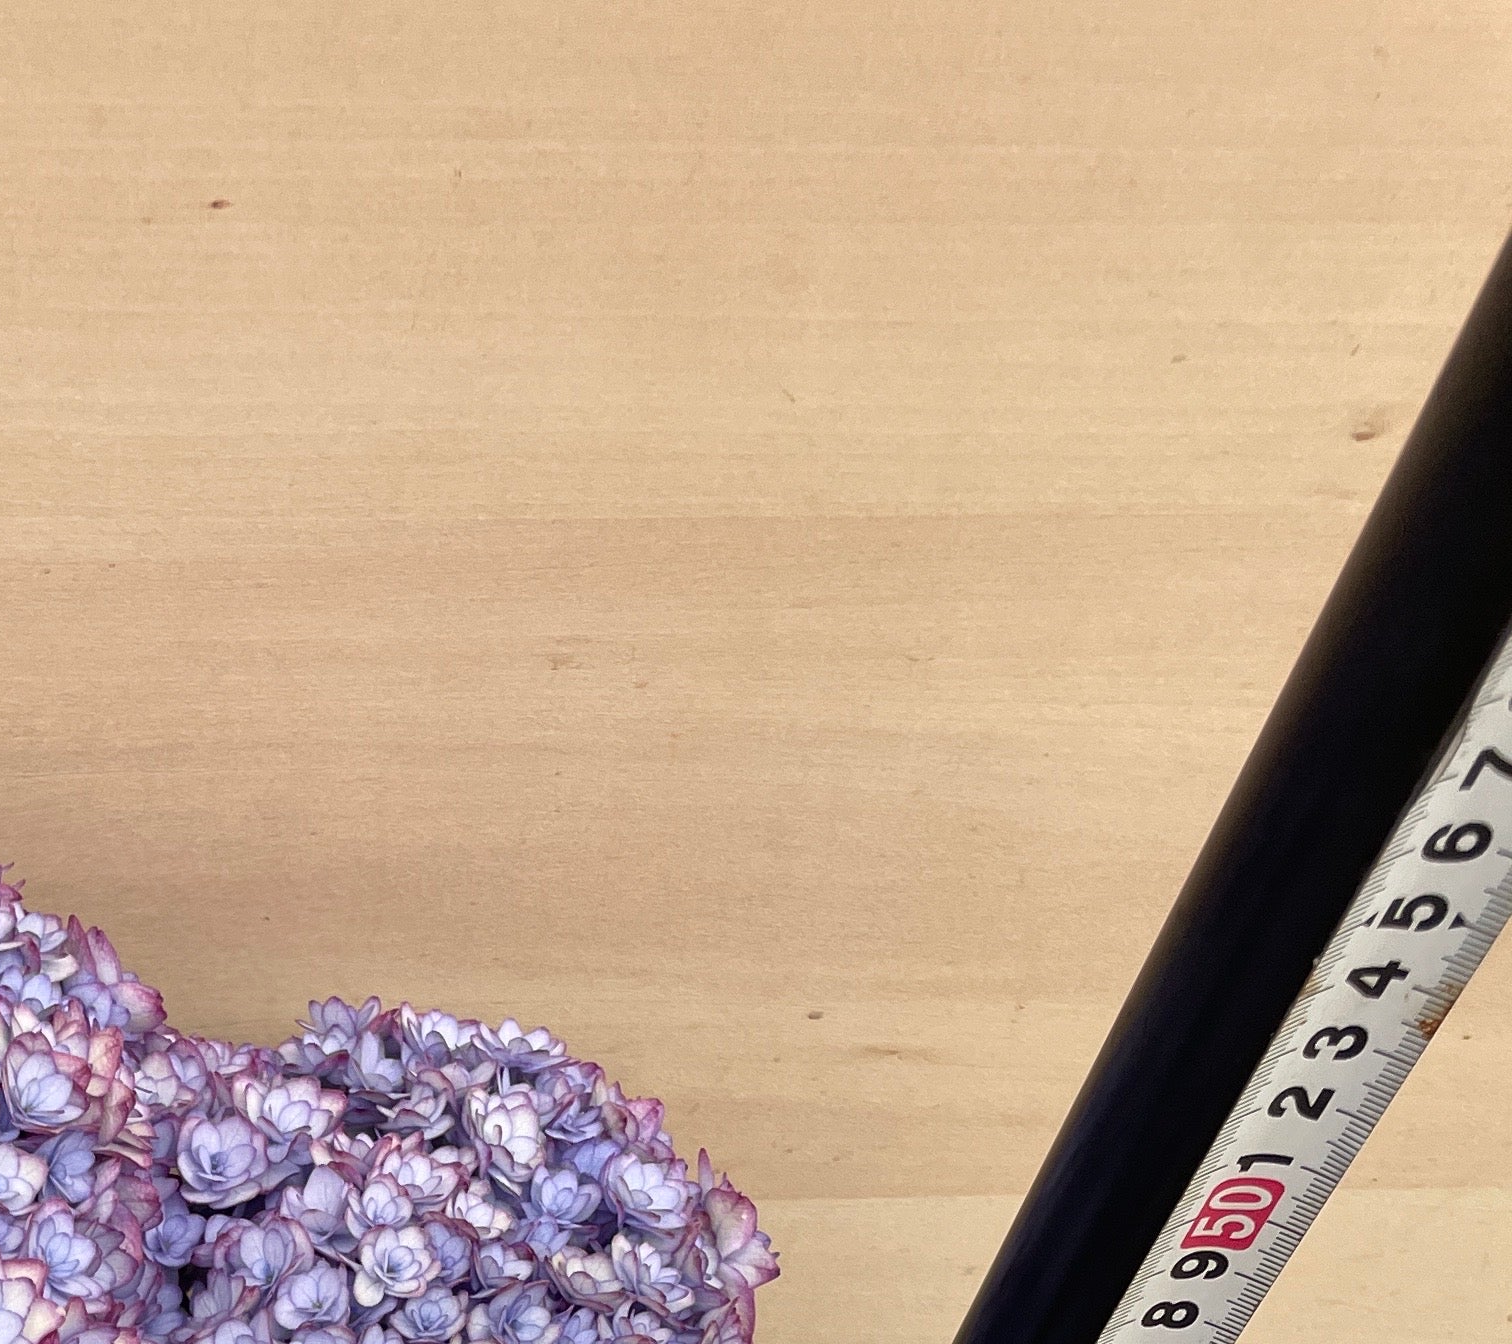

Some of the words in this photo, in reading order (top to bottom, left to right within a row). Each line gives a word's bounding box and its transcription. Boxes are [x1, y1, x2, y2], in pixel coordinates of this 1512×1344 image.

[1460, 747, 1512, 790] 7
[1423, 821, 1492, 862] 6
[1379, 895, 1448, 931] 5
[1346, 961, 1408, 999] 4
[1303, 1025, 1367, 1060] 3
[1268, 1086, 1334, 1120] 2
[1237, 1153, 1293, 1172] 1
[1195, 1185, 1274, 1240] 50
[1170, 1251, 1229, 1279] 9
[1141, 1301, 1199, 1329] 8
